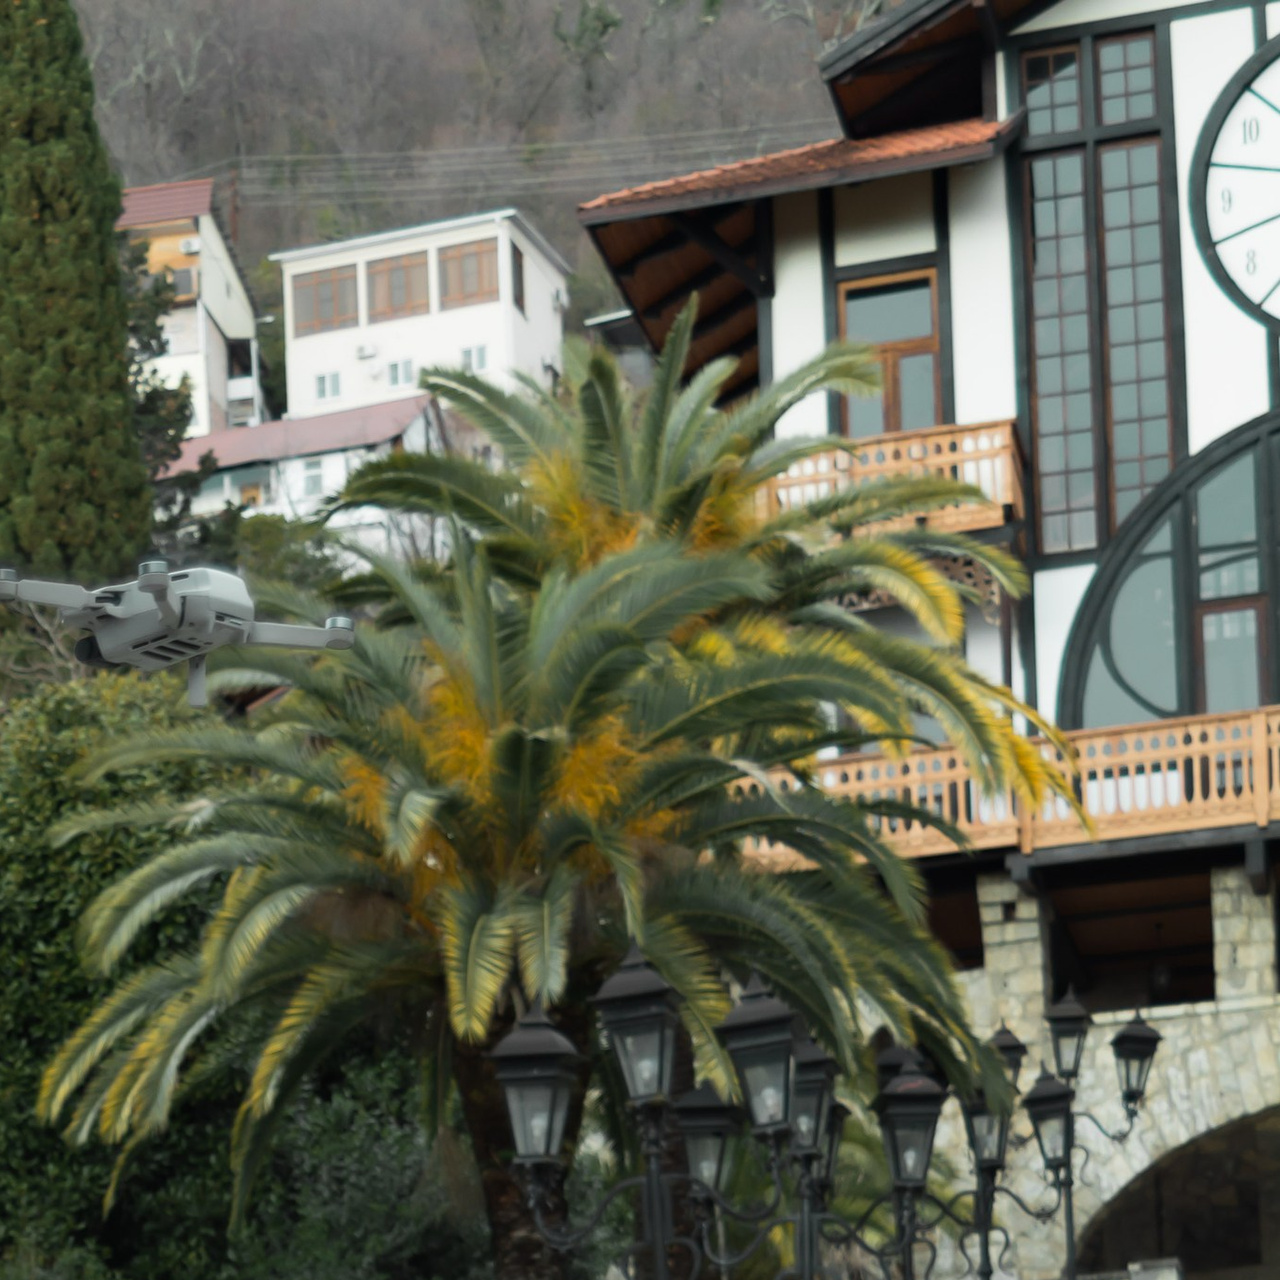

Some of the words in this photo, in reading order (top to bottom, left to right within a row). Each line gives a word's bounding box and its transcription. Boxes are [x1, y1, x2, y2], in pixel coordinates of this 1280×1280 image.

[1243, 118, 1259, 143] 10
[1221, 189, 1232, 212] 9
[1246, 250, 1257, 275] 8
